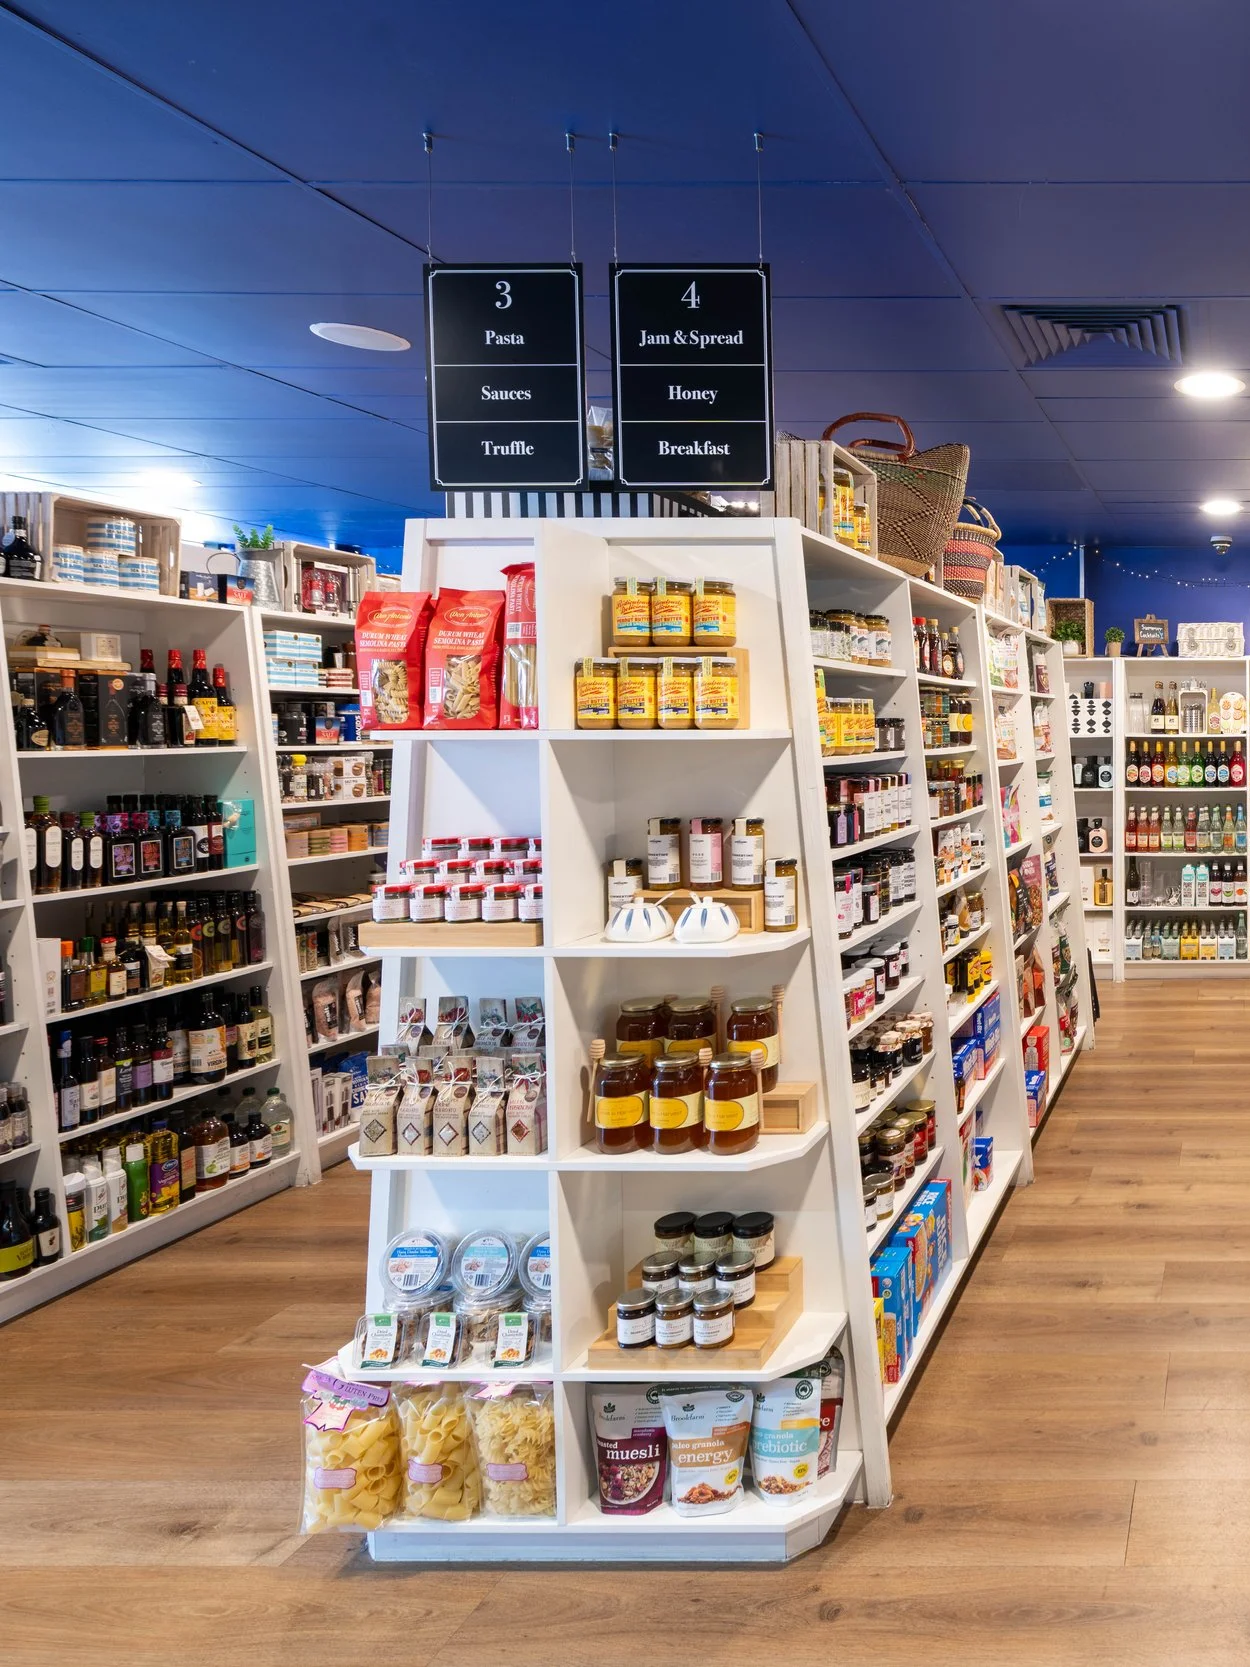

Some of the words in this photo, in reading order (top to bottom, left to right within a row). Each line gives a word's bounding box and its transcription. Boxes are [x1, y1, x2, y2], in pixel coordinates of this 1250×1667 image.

[495, 281, 512, 309] 3
[681, 281, 700, 309] 4
[485, 330, 525, 345] Pasta
[639, 330, 670, 347] Jam
[673, 330, 688, 345] &
[689, 330, 743, 349] Spread
[481, 385, 531, 401] Sauces
[668, 386, 718, 404] Honey
[481, 441, 534, 456] Truffle
[658, 441, 730, 456] Breakfast
[438, 630, 462, 638] DURUM
[1140, 630, 1160, 638] Cocktails
[1141, 623, 1163, 631] Summer
[433, 638, 465, 646] SEMOLINA
[606, 1444, 660, 1460] muesli
[691, 1439, 725, 1450] granola
[678, 1447, 733, 1464] energy
